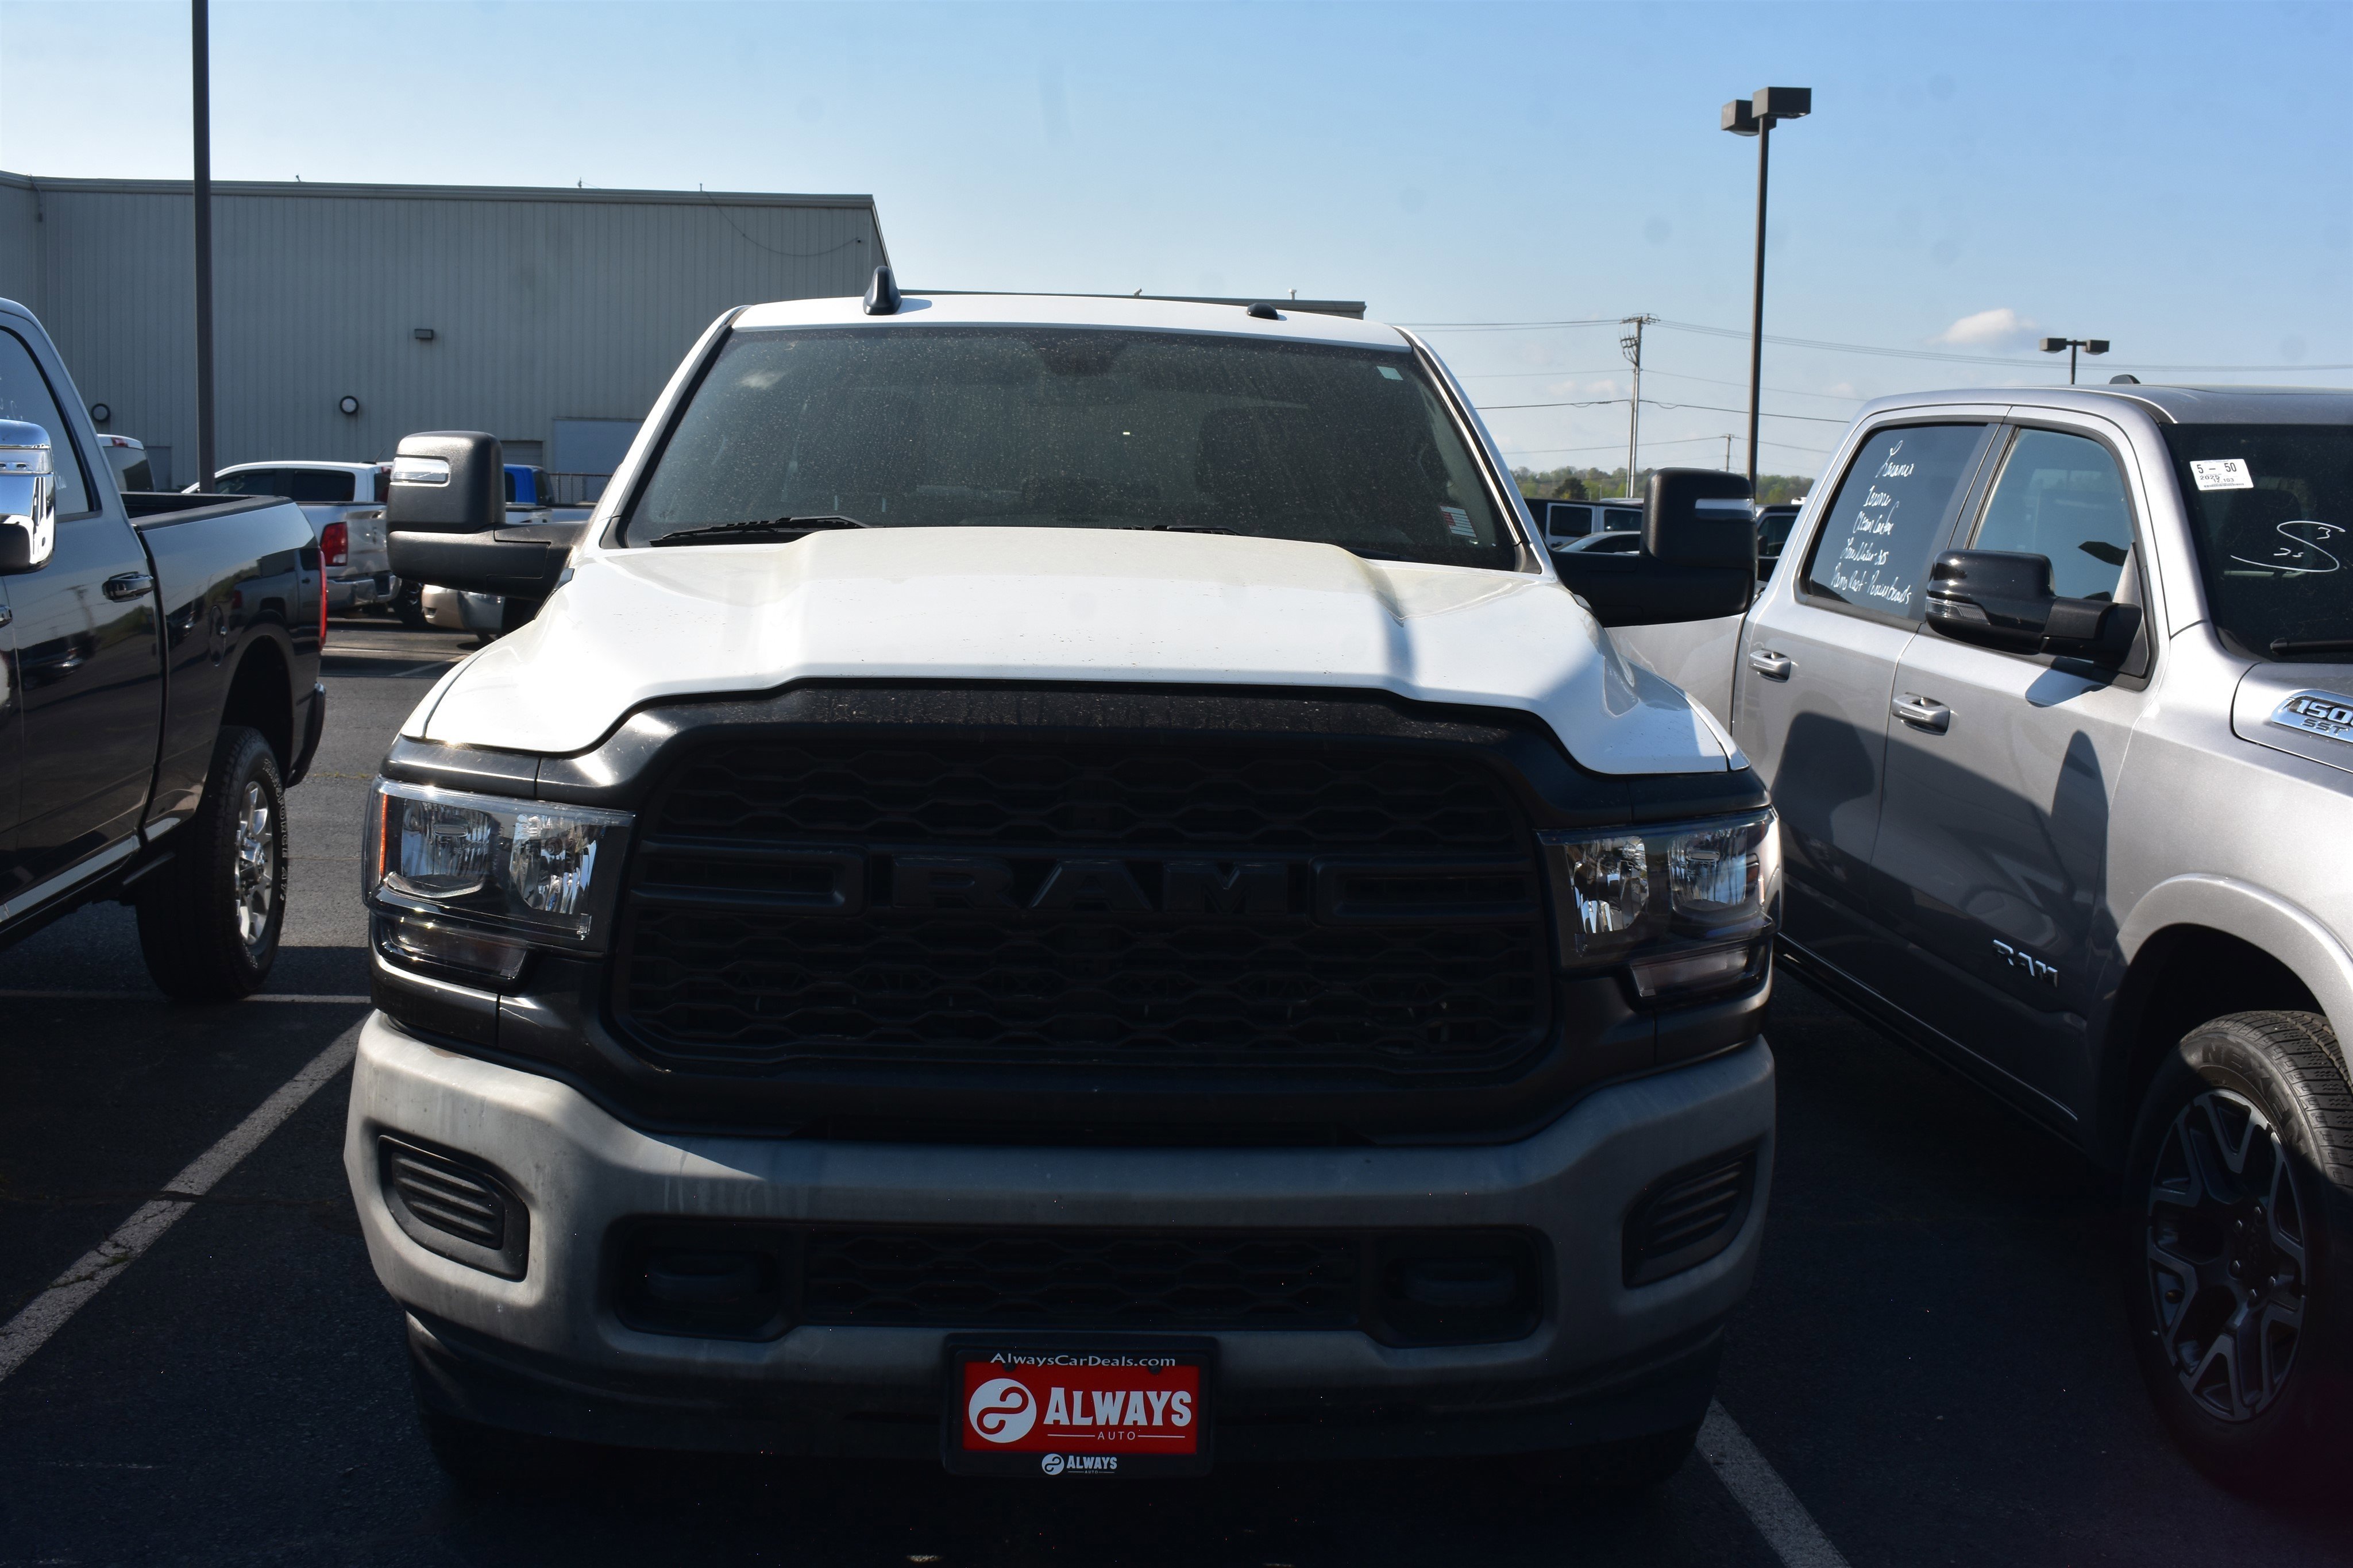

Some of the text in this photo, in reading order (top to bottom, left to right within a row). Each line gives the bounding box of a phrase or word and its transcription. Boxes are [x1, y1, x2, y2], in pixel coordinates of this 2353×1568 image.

[2224, 462, 2237, 472] 50
[2296, 699, 2353, 726] 150
[2301, 718, 2350, 736] SST
[892, 855, 1289, 916] RAM
[990, 1353, 1176, 1367] AlwaysCarDeals.com
[1043, 1387, 1192, 1427] ALWAYS
[1097, 1431, 1136, 1440] AUTO
[1067, 1455, 1117, 1469] ALWAYS
